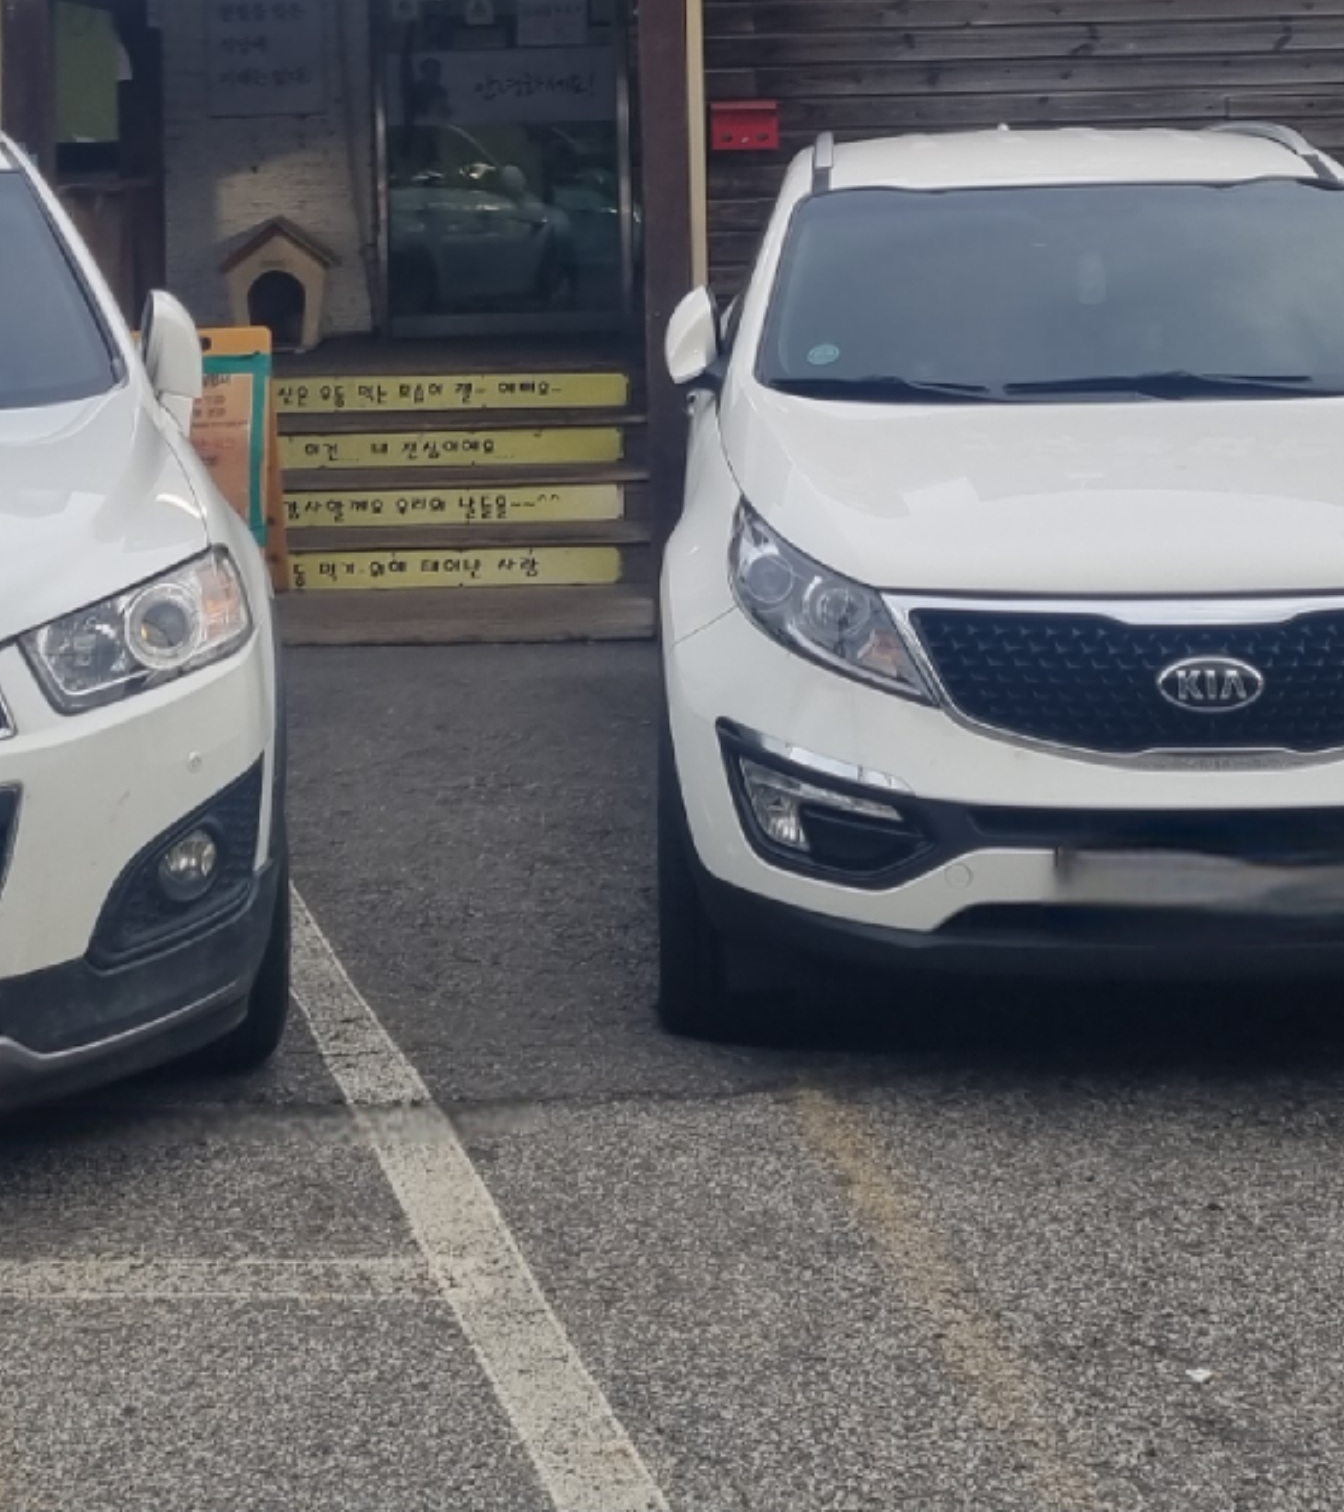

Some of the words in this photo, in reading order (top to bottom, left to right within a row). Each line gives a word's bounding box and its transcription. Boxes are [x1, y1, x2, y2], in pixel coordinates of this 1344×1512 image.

[319, 384, 345, 408] 우동
[358, 383, 388, 404] 먹는
[398, 382, 444, 404] 모습이
[319, 562, 355, 583] 먹기
[421, 560, 482, 580] 태어난
[497, 558, 539, 578] 사람
[1175, 669, 1247, 701] KIA
